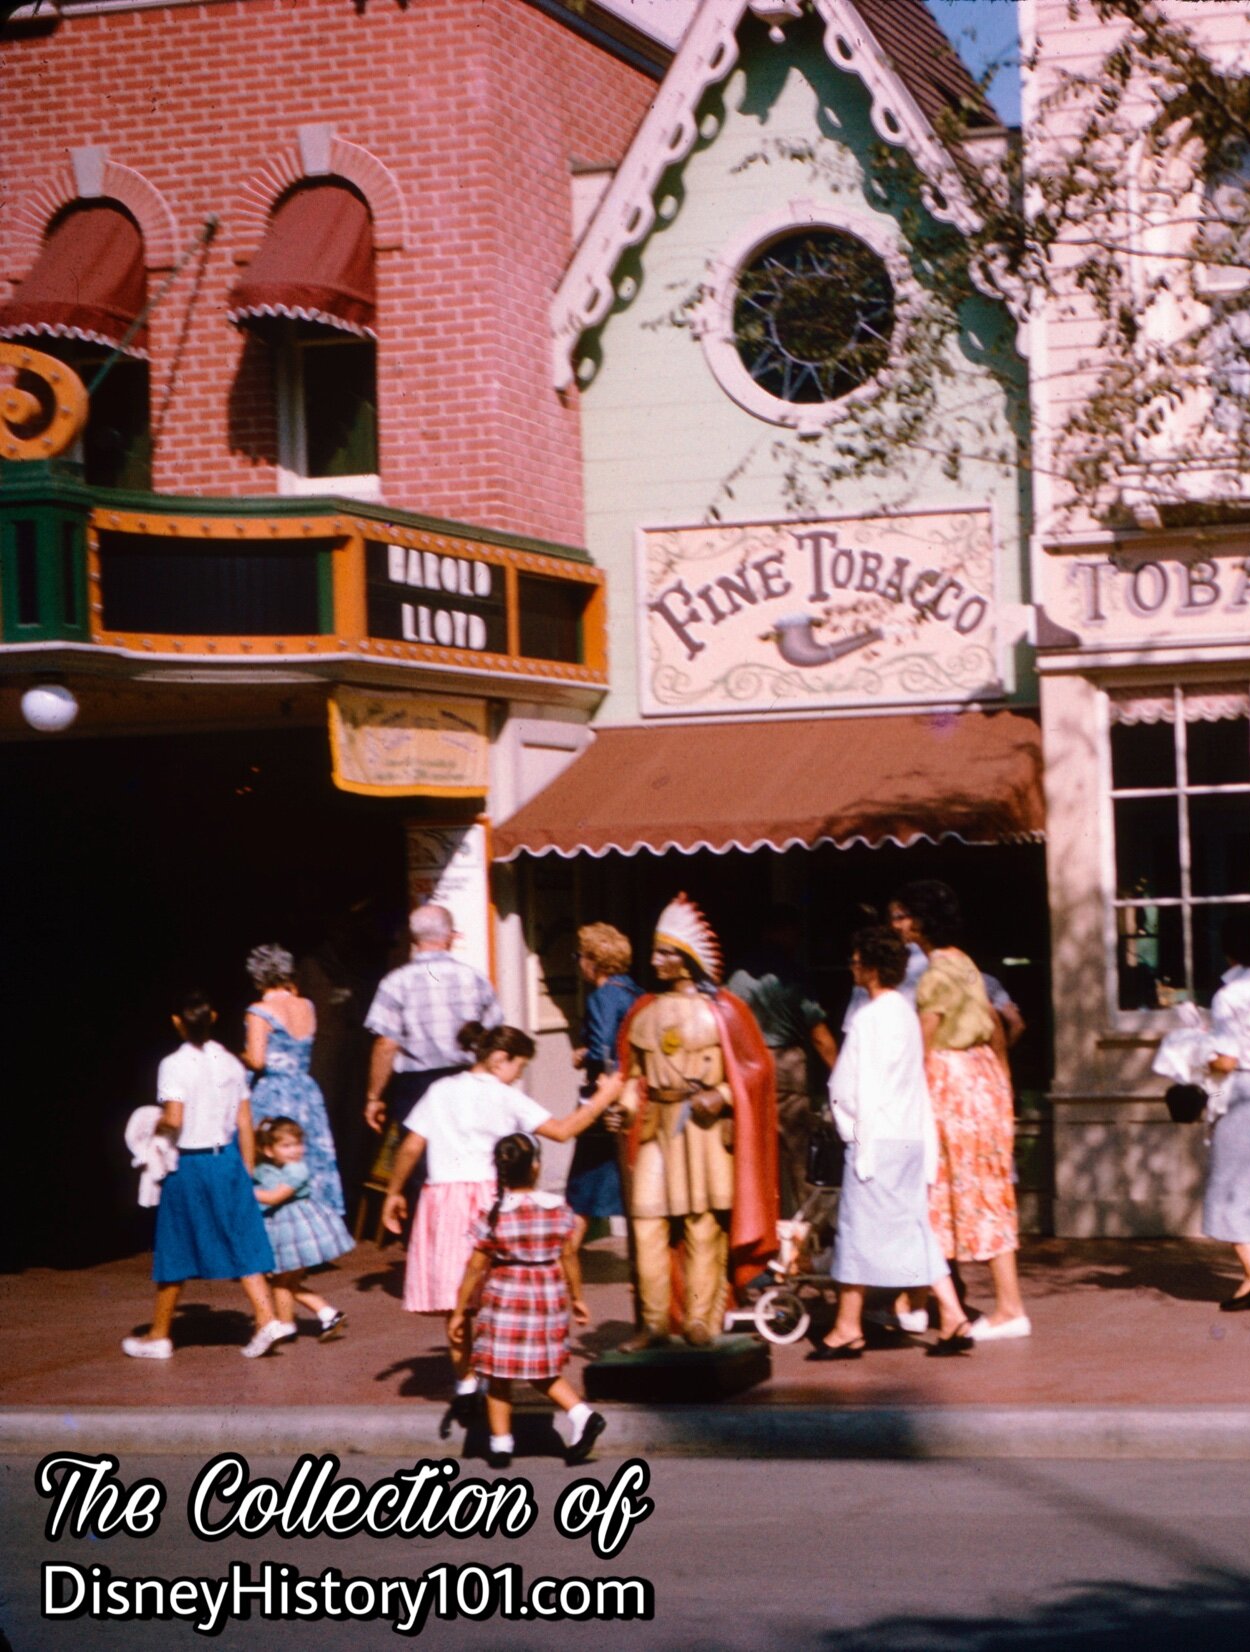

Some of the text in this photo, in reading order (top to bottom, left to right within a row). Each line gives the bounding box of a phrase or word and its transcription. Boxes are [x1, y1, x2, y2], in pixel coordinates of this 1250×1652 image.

[388, 544, 491, 597] HAROLD
[647, 530, 987, 661] FINE TOBACCO
[401, 603, 487, 650] LLOYD
